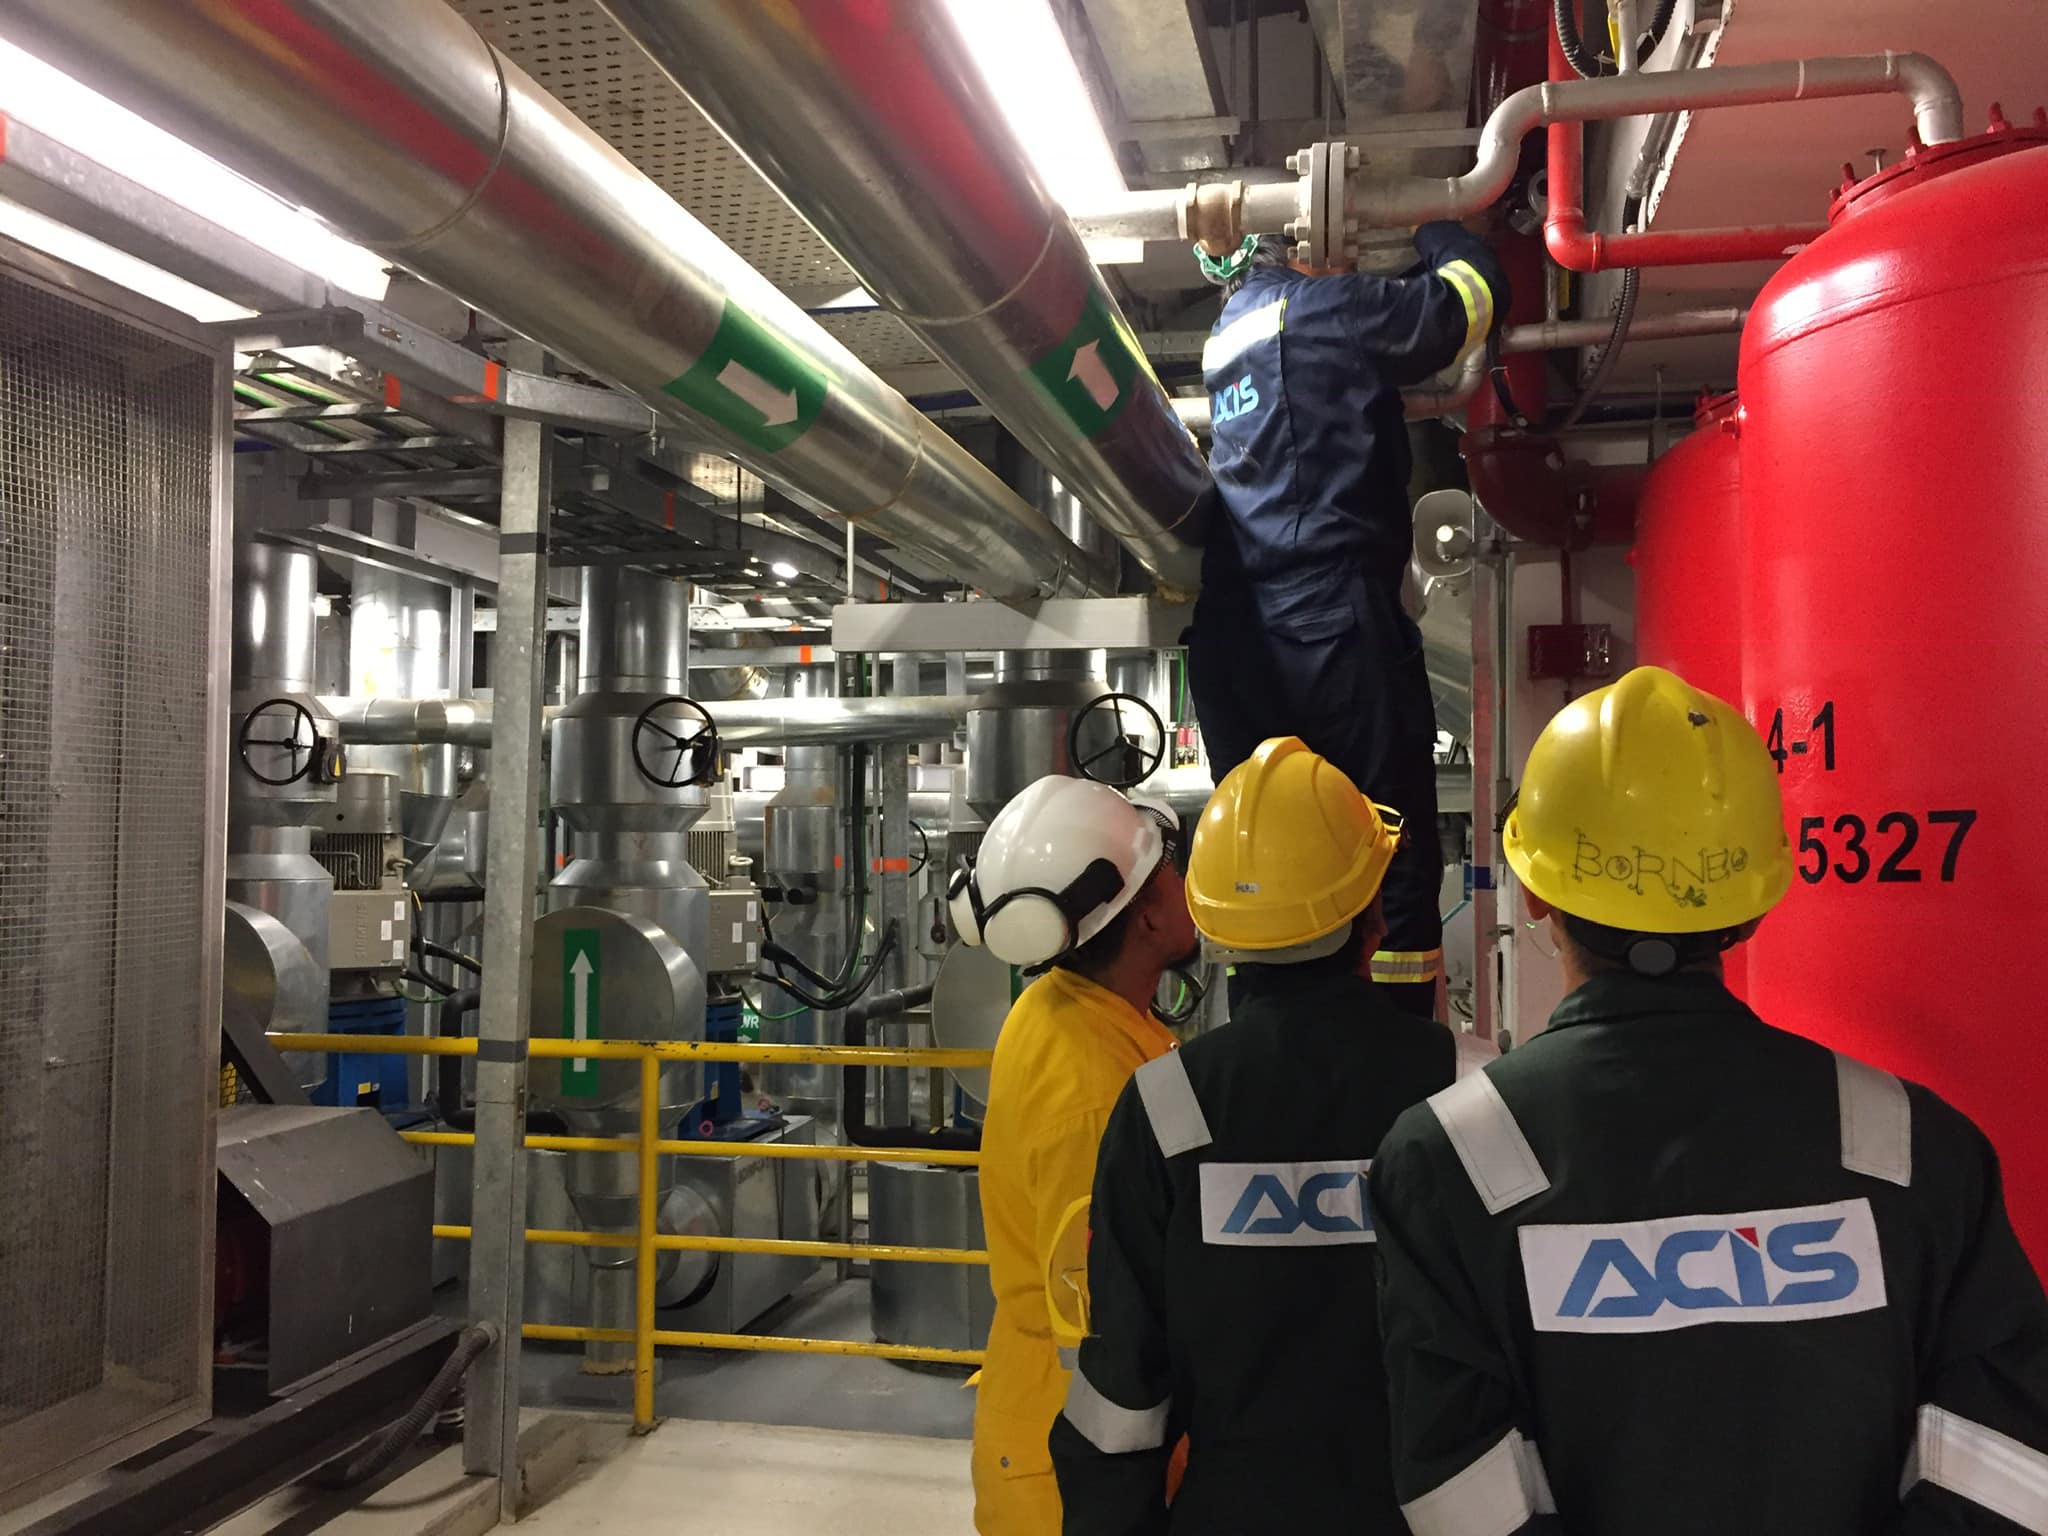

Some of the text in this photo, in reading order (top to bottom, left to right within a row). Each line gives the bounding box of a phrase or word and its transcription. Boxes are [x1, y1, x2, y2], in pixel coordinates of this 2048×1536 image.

[1212, 374, 1259, 424] ACIS
[1767, 700, 1835, 773] 4-1
[1573, 829, 1748, 902] BORNEO
[1798, 809, 1977, 884] 5327
[1556, 1217, 1860, 1318] ACIS
